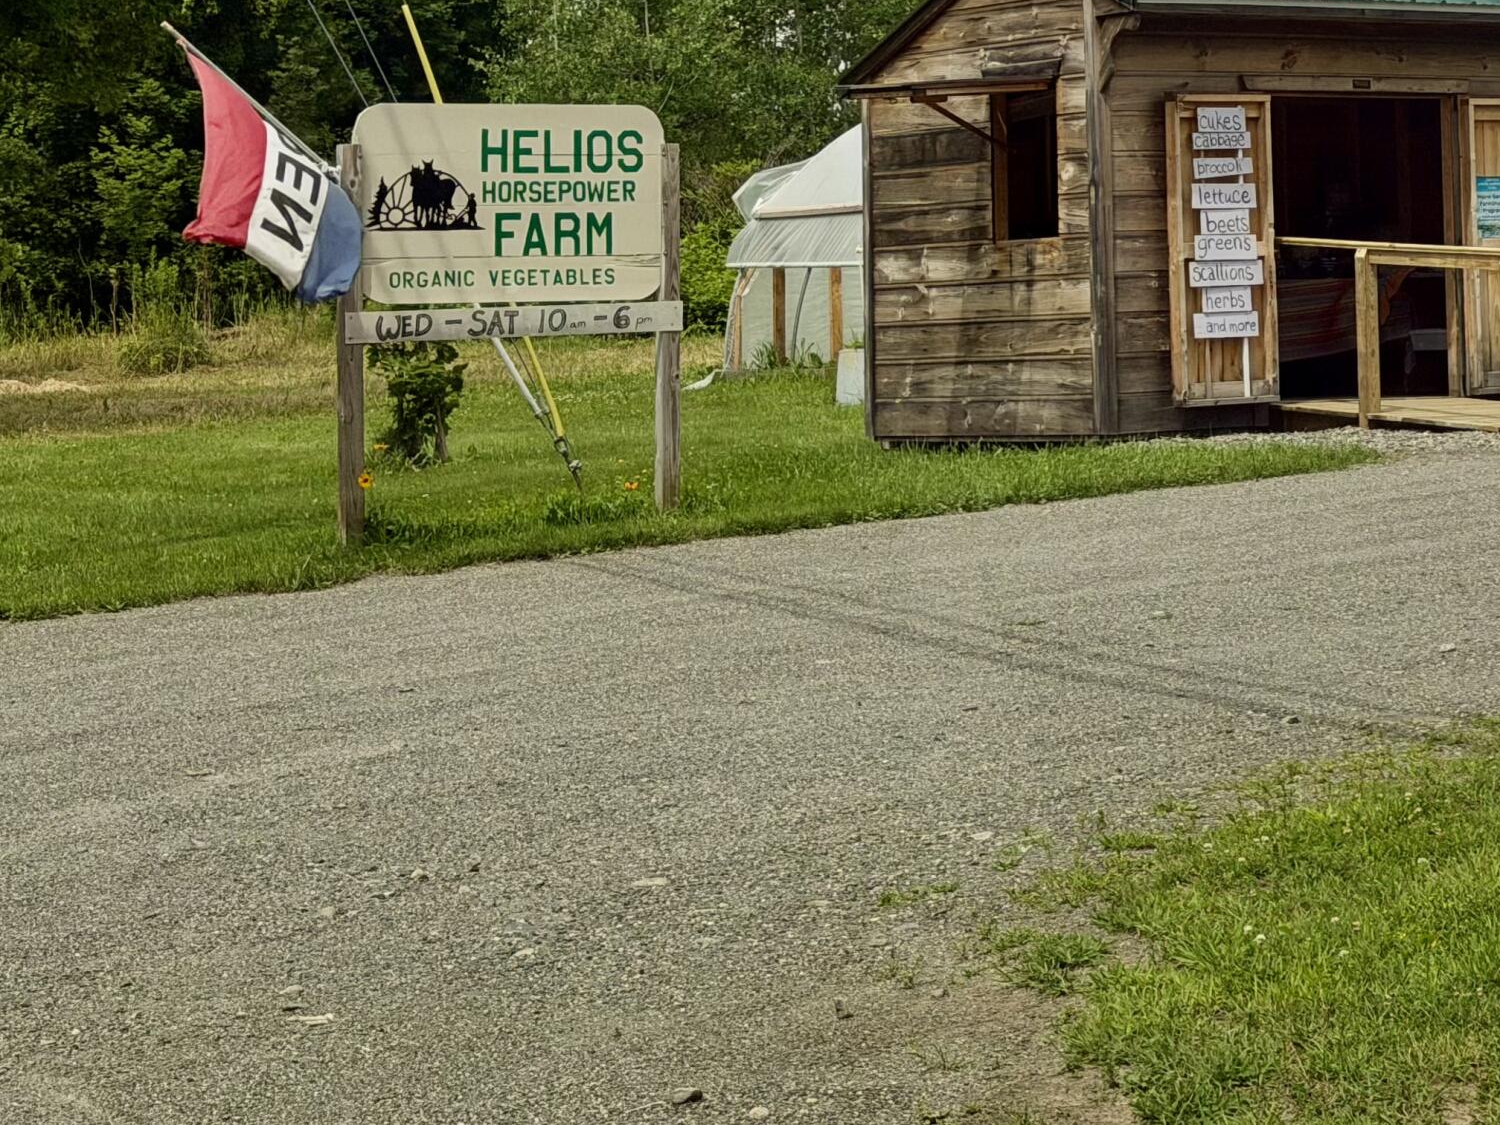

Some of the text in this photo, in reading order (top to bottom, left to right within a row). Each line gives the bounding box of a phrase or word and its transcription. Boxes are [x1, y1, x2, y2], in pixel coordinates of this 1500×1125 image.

[1200, 111, 1242, 131] cukes
[481, 128, 644, 173] HELIOS
[1195, 134, 1245, 148] cabbage
[1197, 160, 1243, 175] broccoli
[482, 180, 636, 203] HORSEPOWER
[1198, 186, 1251, 204] lettuce
[1204, 211, 1249, 233] beets
[494, 212, 613, 257] FARM
[1198, 236, 1251, 258] greens
[389, 268, 616, 289] ORGANIC VEGETABLES
[1192, 263, 1254, 283] scallions
[1205, 288, 1246, 309] herbs
[375, 313, 433, 342] WED
[467, 309, 519, 337] SAT
[1229, 321, 1257, 334] more
